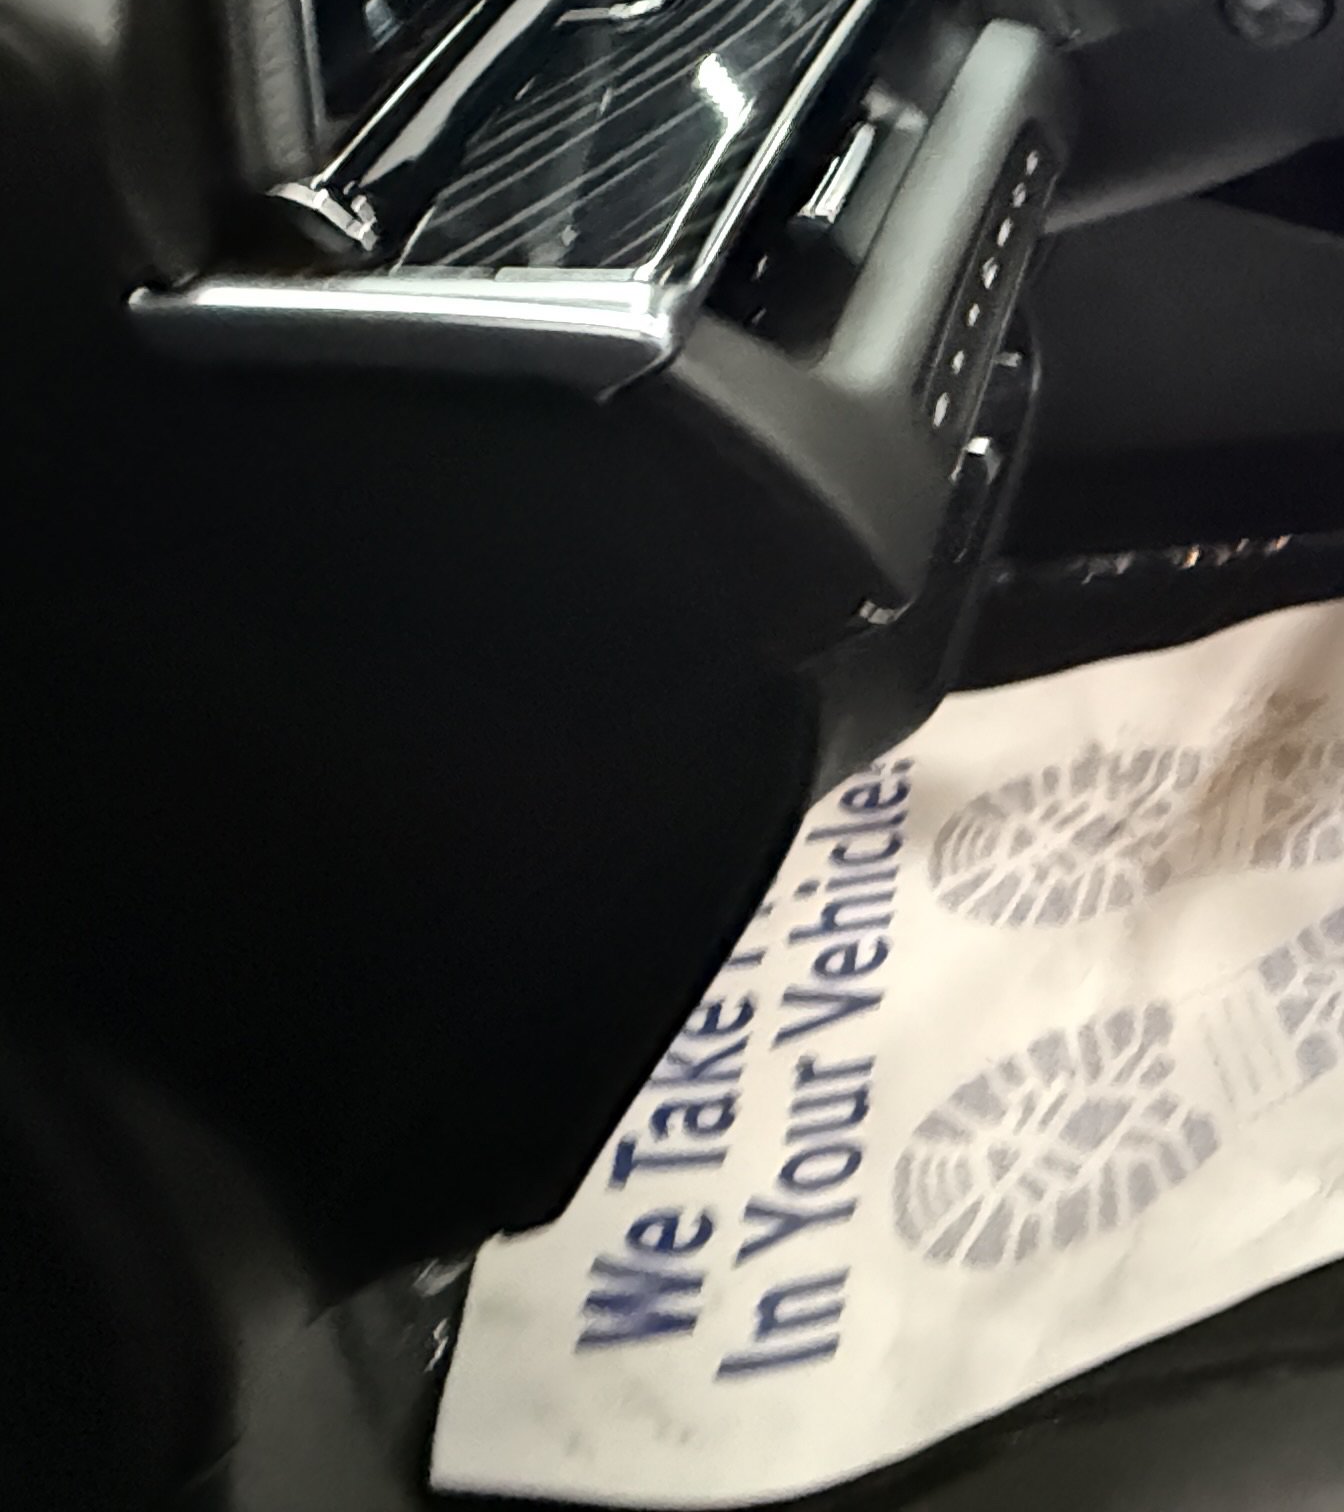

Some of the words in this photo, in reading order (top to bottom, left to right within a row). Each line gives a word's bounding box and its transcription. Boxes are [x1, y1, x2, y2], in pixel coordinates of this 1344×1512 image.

[607, 994, 755, 1191] Take
[734, 1055, 876, 1267] Your
[574, 1206, 716, 1354] We
[714, 1265, 850, 1381] In
